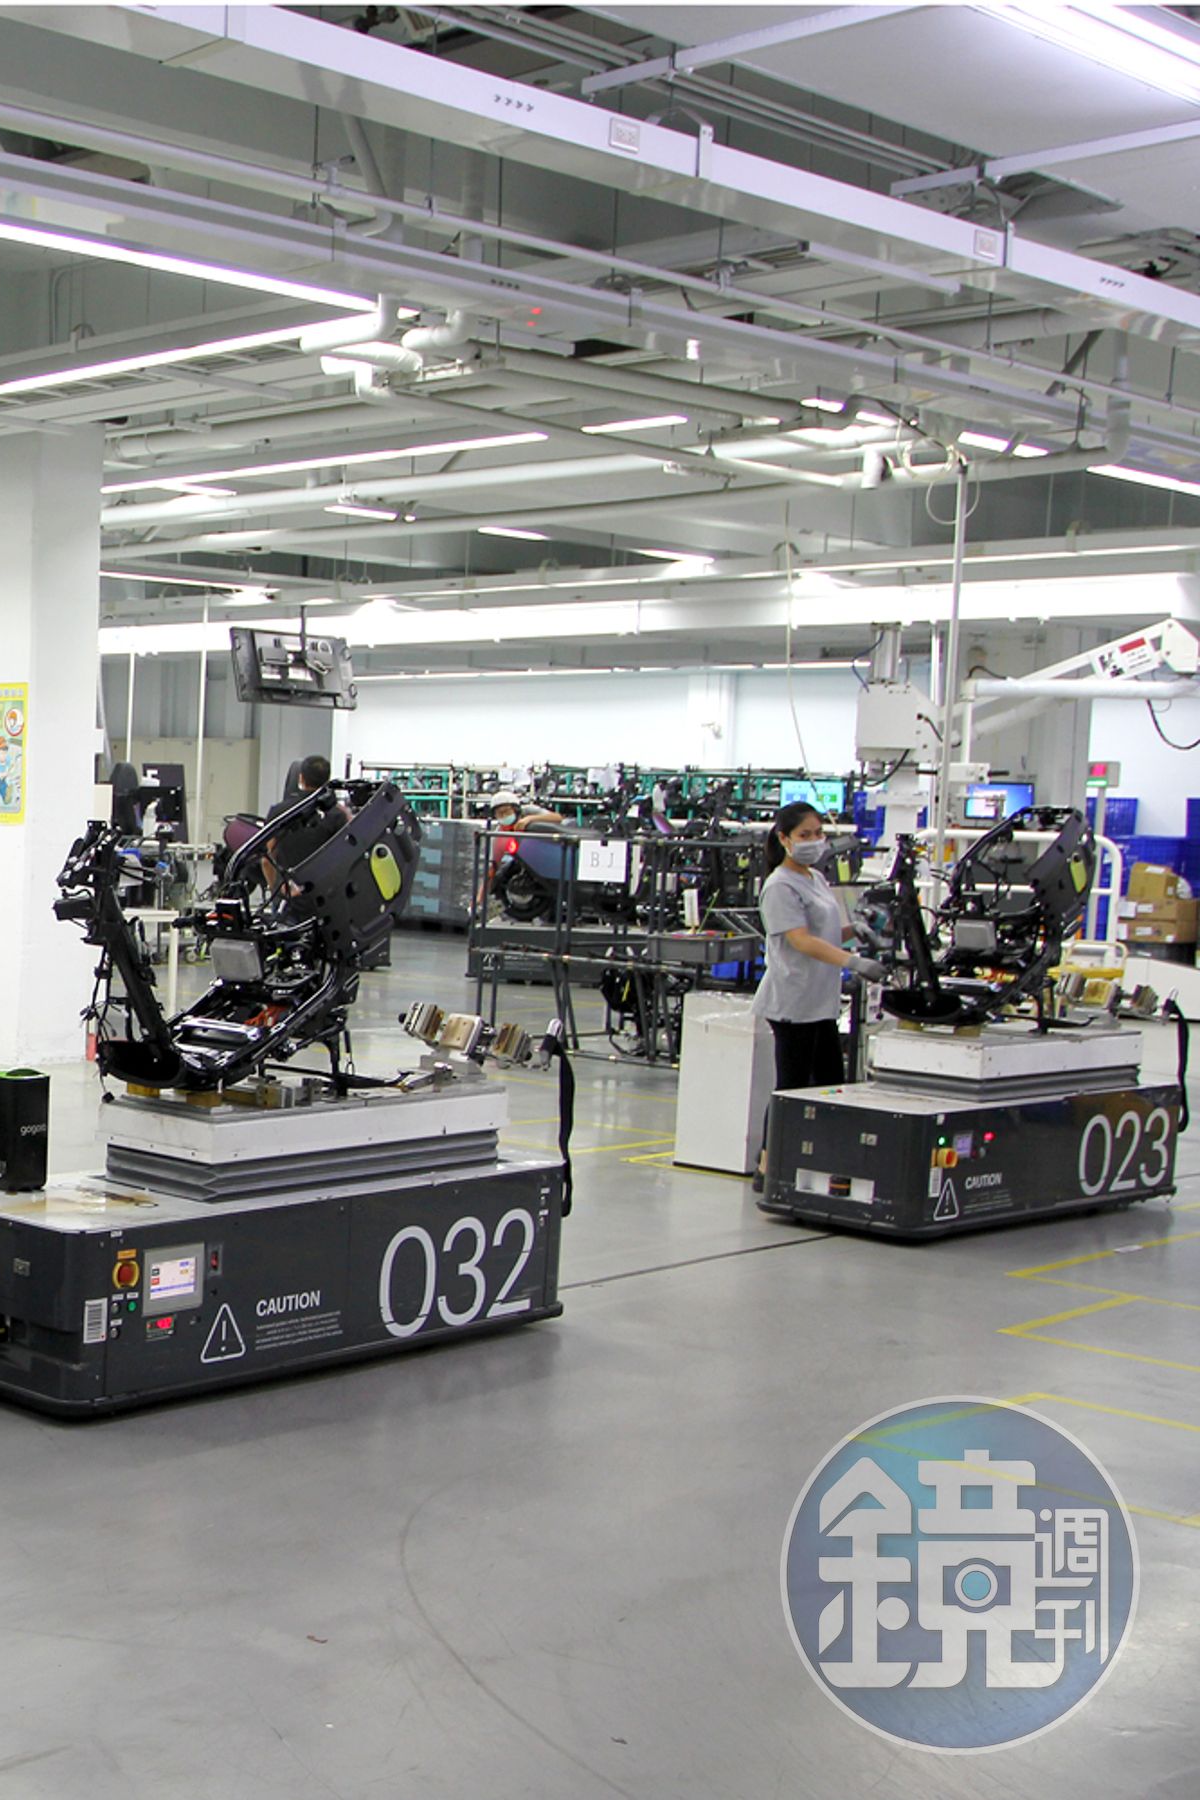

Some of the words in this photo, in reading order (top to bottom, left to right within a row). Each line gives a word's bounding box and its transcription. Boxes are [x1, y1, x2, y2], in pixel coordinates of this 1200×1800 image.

[1079, 1107, 1170, 1196] 023
[965, 1173, 1002, 1190] CAUTION
[379, 1208, 535, 1337] 032
[256, 1290, 321, 1316] CAUTION
